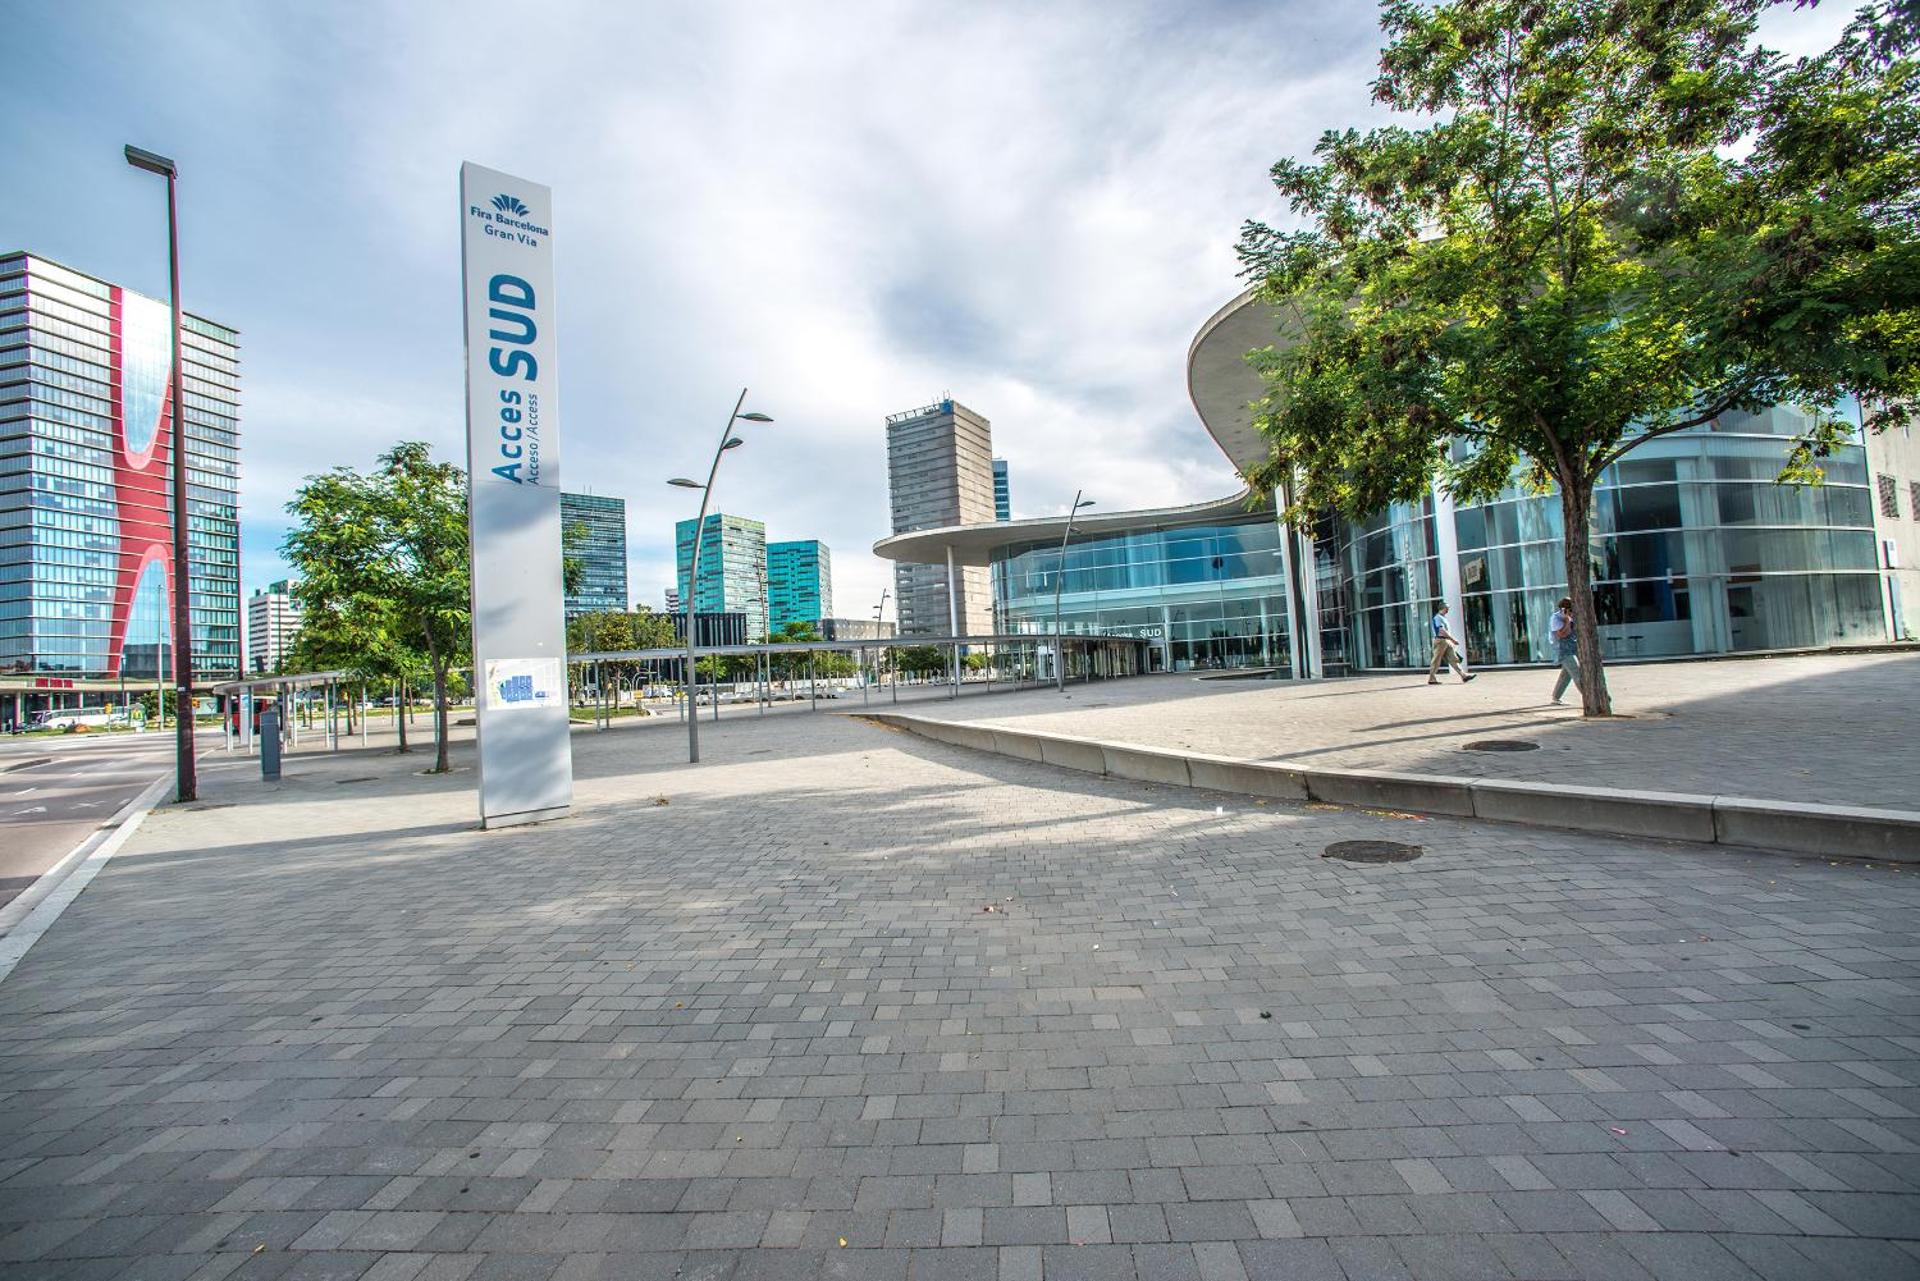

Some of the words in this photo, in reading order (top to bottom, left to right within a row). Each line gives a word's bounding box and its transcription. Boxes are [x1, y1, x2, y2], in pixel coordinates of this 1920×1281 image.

[470, 205, 492, 220] Fira
[495, 213, 549, 236] Barcelona
[484, 224, 515, 241] Gran
[517, 232, 537, 247] Via
[488, 273, 538, 382] SUD
[1139, 628, 1162, 638] SUD
